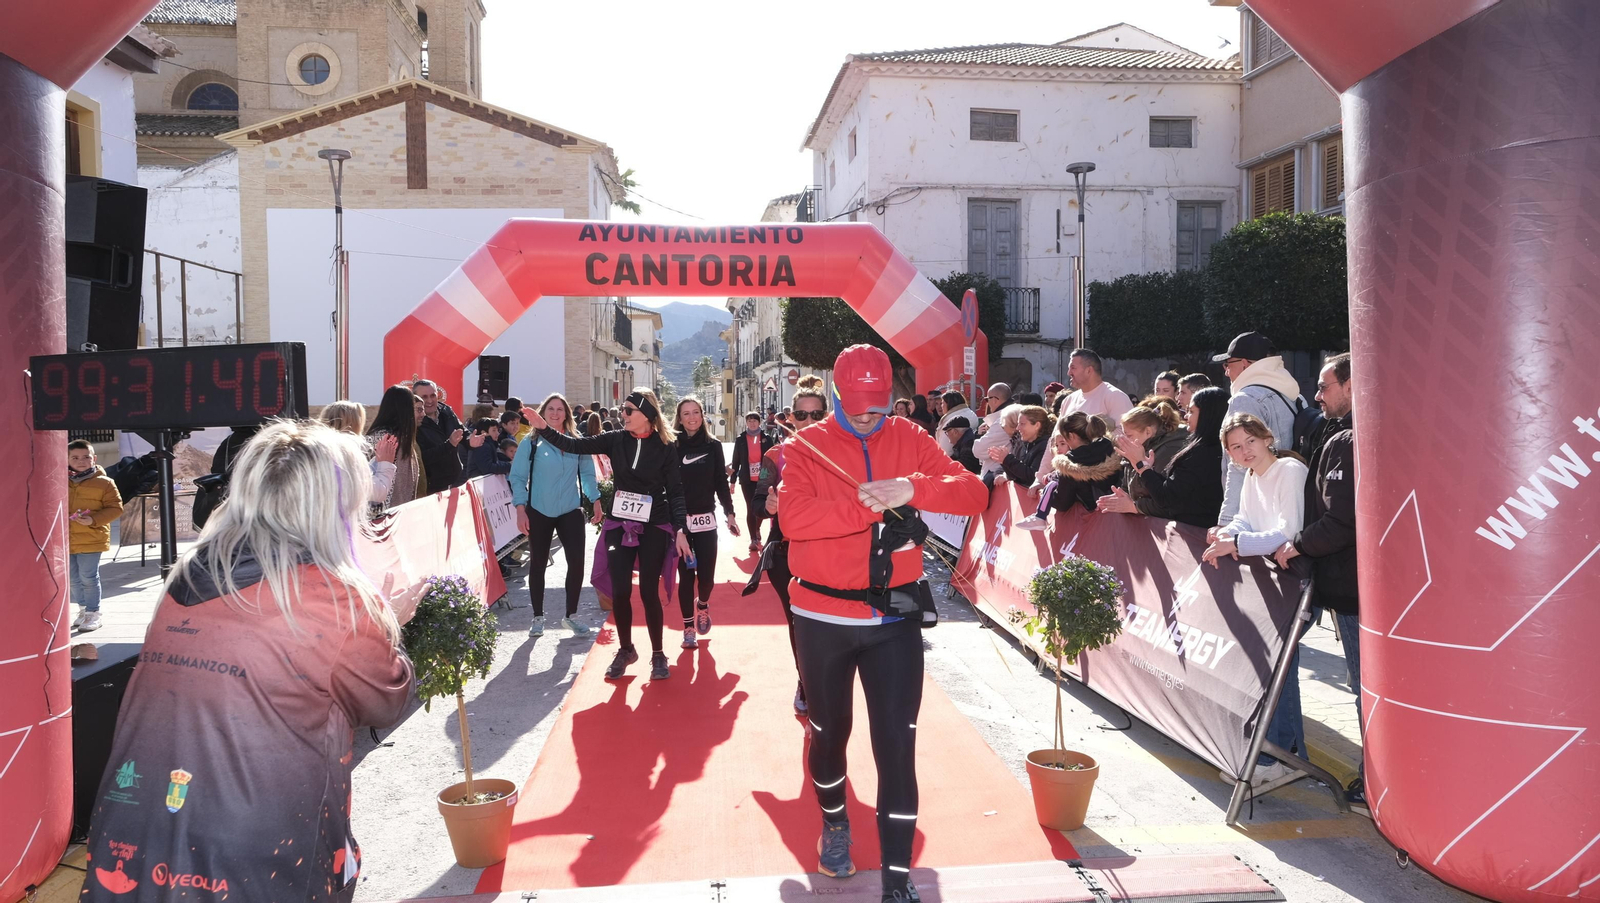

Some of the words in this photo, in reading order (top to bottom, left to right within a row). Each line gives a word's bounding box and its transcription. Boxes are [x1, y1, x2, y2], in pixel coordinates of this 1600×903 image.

[578, 223, 804, 244] AYUNTAMIENTO
[585, 252, 796, 287] CANTORIA
[1475, 406, 1600, 550] www.t
[621, 500, 644, 514] 517
[692, 515, 711, 526] 468
[1121, 602, 1237, 670] TEAMERGY
[151, 652, 164, 664] DE
[166, 654, 247, 679] ALMANZORA
